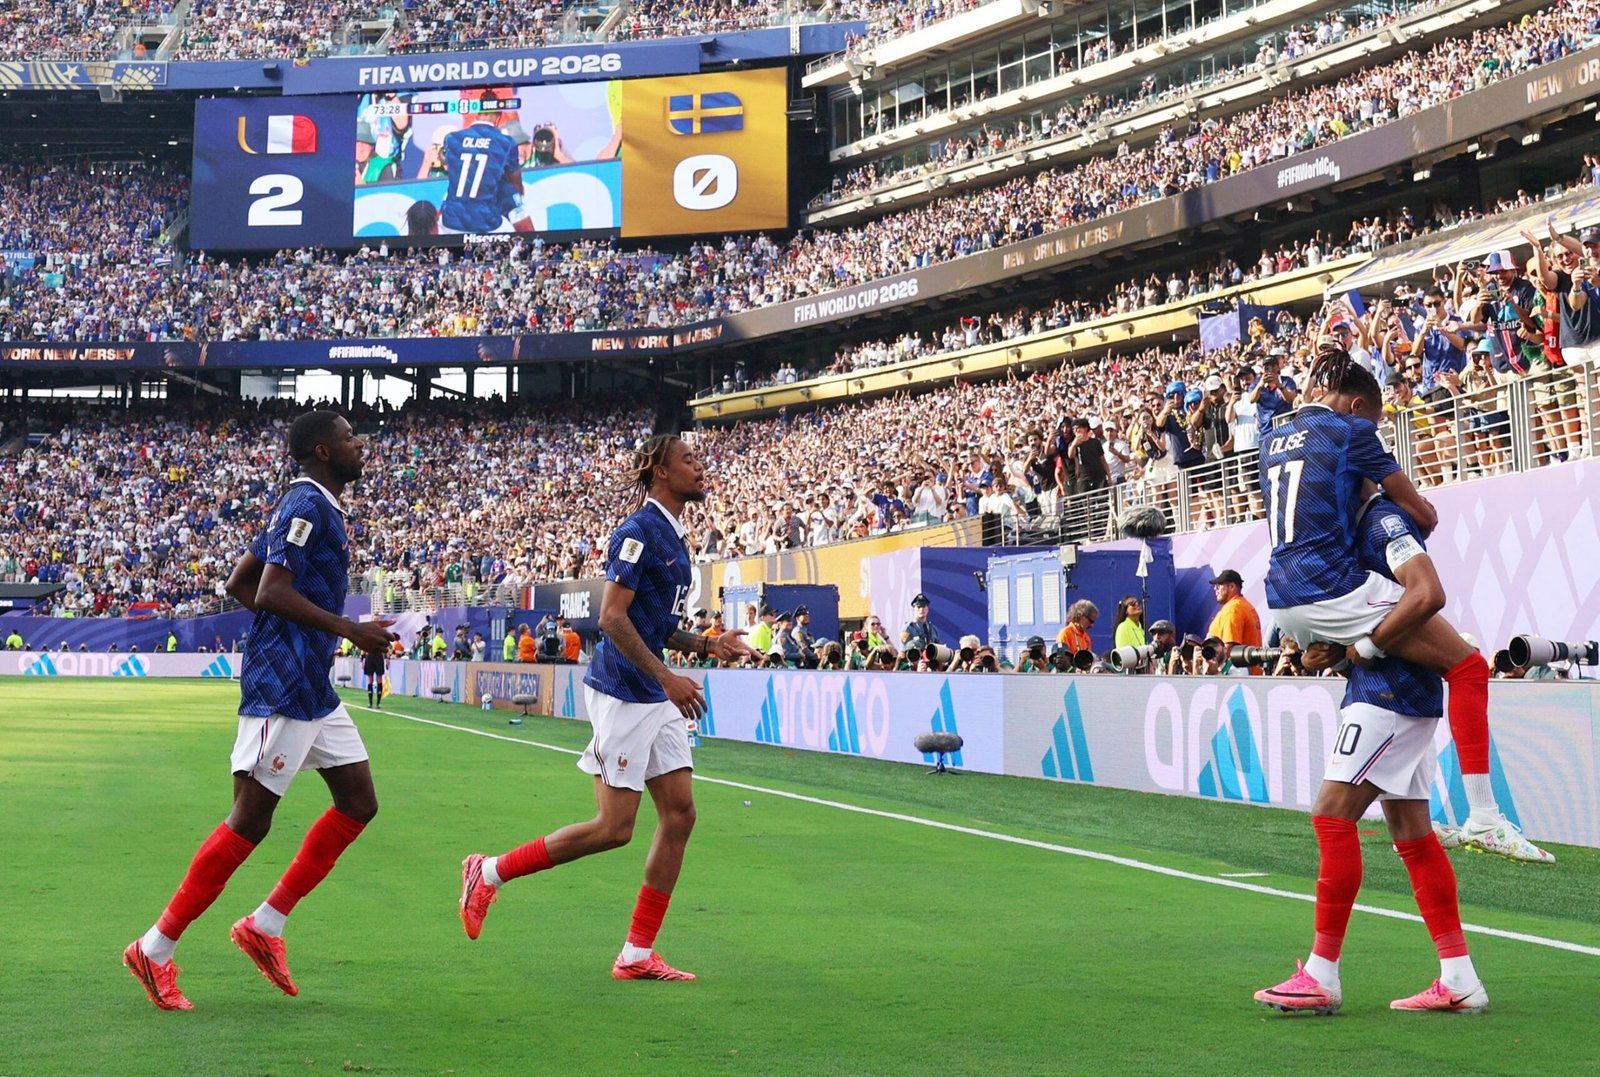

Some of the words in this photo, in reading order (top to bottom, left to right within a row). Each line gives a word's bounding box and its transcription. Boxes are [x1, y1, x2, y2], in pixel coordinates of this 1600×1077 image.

[359, 66, 405, 86] FIFA
[408, 61, 489, 83] WORLD
[493, 58, 539, 78] CUP
[541, 53, 622, 75] 2026
[1527, 73, 1563, 104] NEW
[1567, 58, 1600, 88] YOR
[374, 105, 401, 115] 73:28
[431, 102, 445, 112] FRA
[450, 103, 456, 112] 3
[471, 102, 478, 111] 0
[482, 100, 498, 110] SWE
[462, 136, 492, 149] OLISE
[456, 153, 489, 198] 11
[673, 154, 739, 210] 0
[1277, 156, 1340, 188] #FIFAWorldCup
[248, 174, 304, 226] 2
[463, 233, 511, 244] Hisense
[1003, 251, 1025, 270] NEW
[1029, 242, 1055, 262] ORK
[1081, 222, 1124, 248] JERSEY
[794, 303, 818, 323] FIFA
[818, 293, 857, 318] WORLD
[857, 288, 879, 309] CUP
[879, 278, 919, 304] 2026
[329, 344, 398, 364] #FIFAWorldCup
[592, 337, 625, 351] NEW
[629, 335, 669, 350] YORK
[673, 331, 691, 347] NEW
[692, 324, 723, 344] JERSEY
[1, 348, 42, 361] YORK
[43, 348, 77, 361] NEW
[79, 348, 135, 361] JERSEY
[1269, 430, 1309, 456] OLISE
[1267, 460, 1305, 548] 11
[560, 591, 590, 619] FRANCE
[1144, 682, 1340, 806] aram
[1333, 723, 1362, 756] 10
